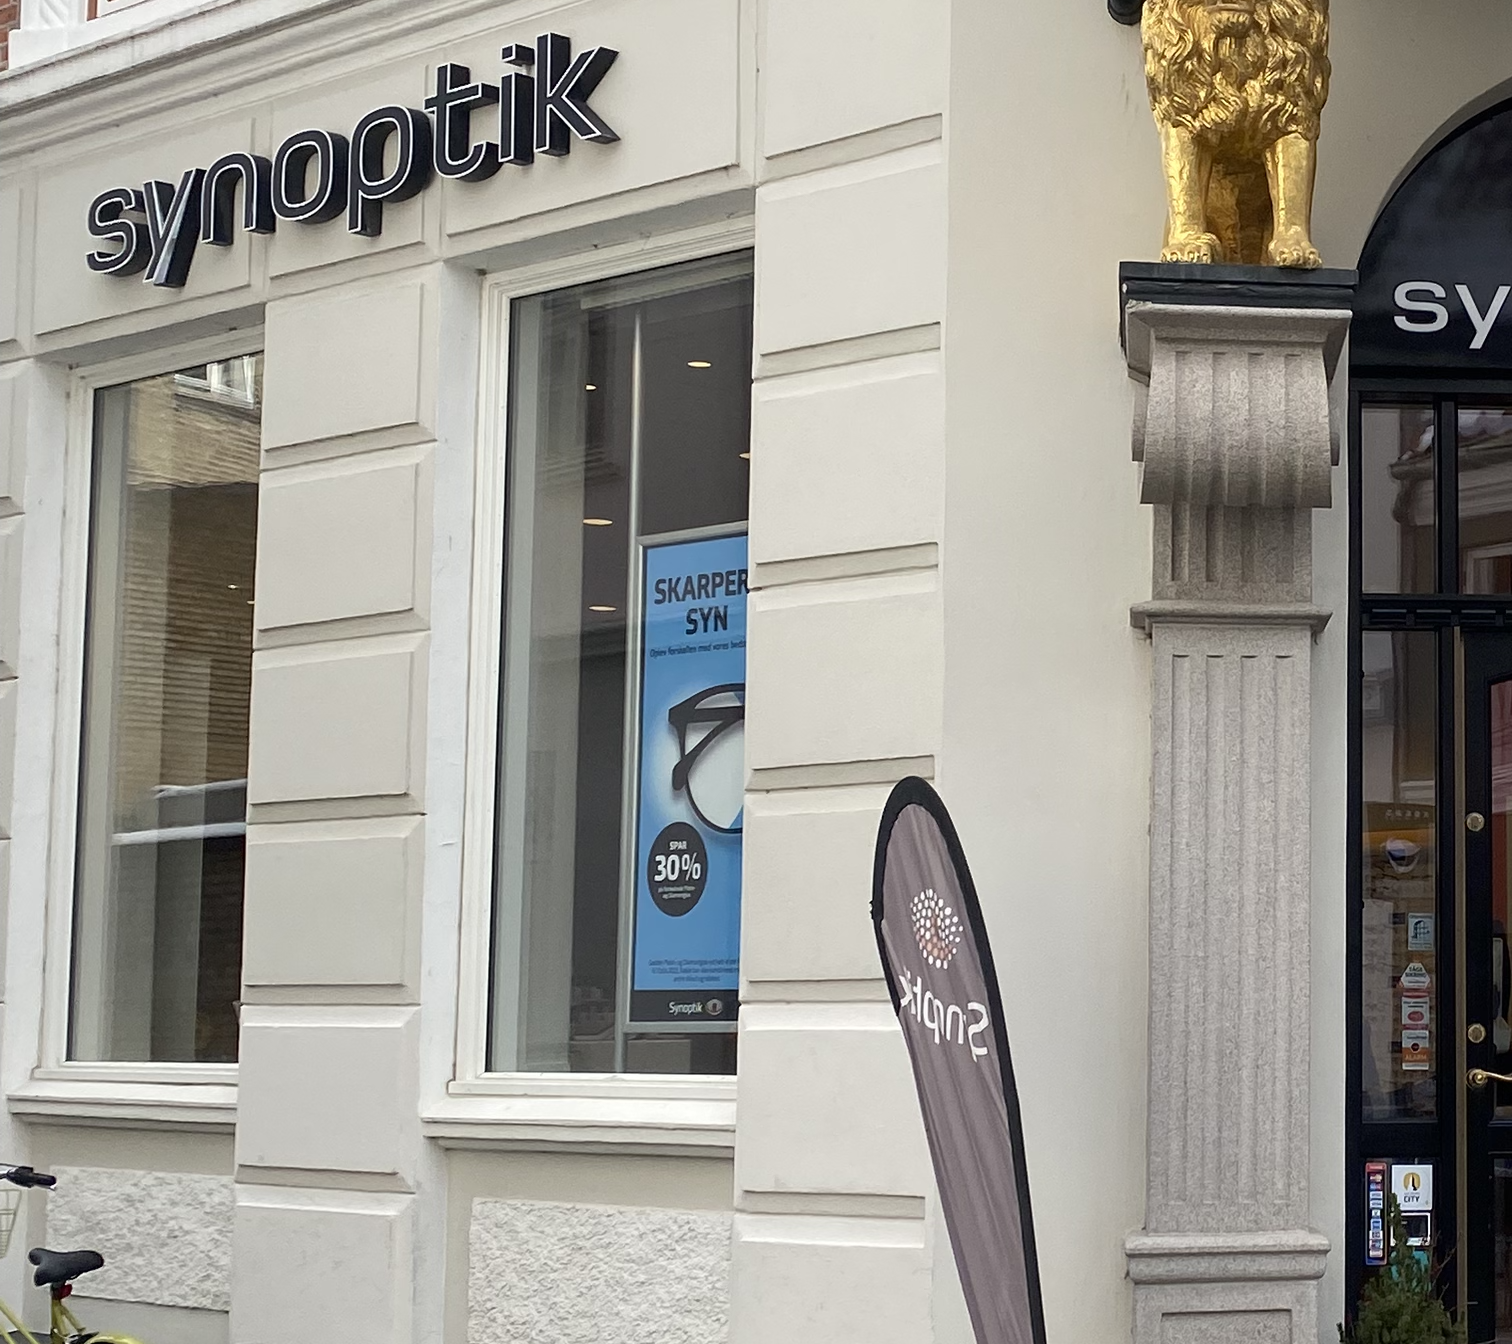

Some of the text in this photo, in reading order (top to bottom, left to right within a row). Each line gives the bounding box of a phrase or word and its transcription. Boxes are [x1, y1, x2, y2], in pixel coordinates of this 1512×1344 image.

[86, 32, 620, 288] synoptik
[654, 568, 749, 605] SKARPER
[685, 605, 728, 635] SYN
[669, 840, 688, 851] SPAR
[653, 852, 702, 882] 30%
[668, 1001, 703, 1017] Synoptik
